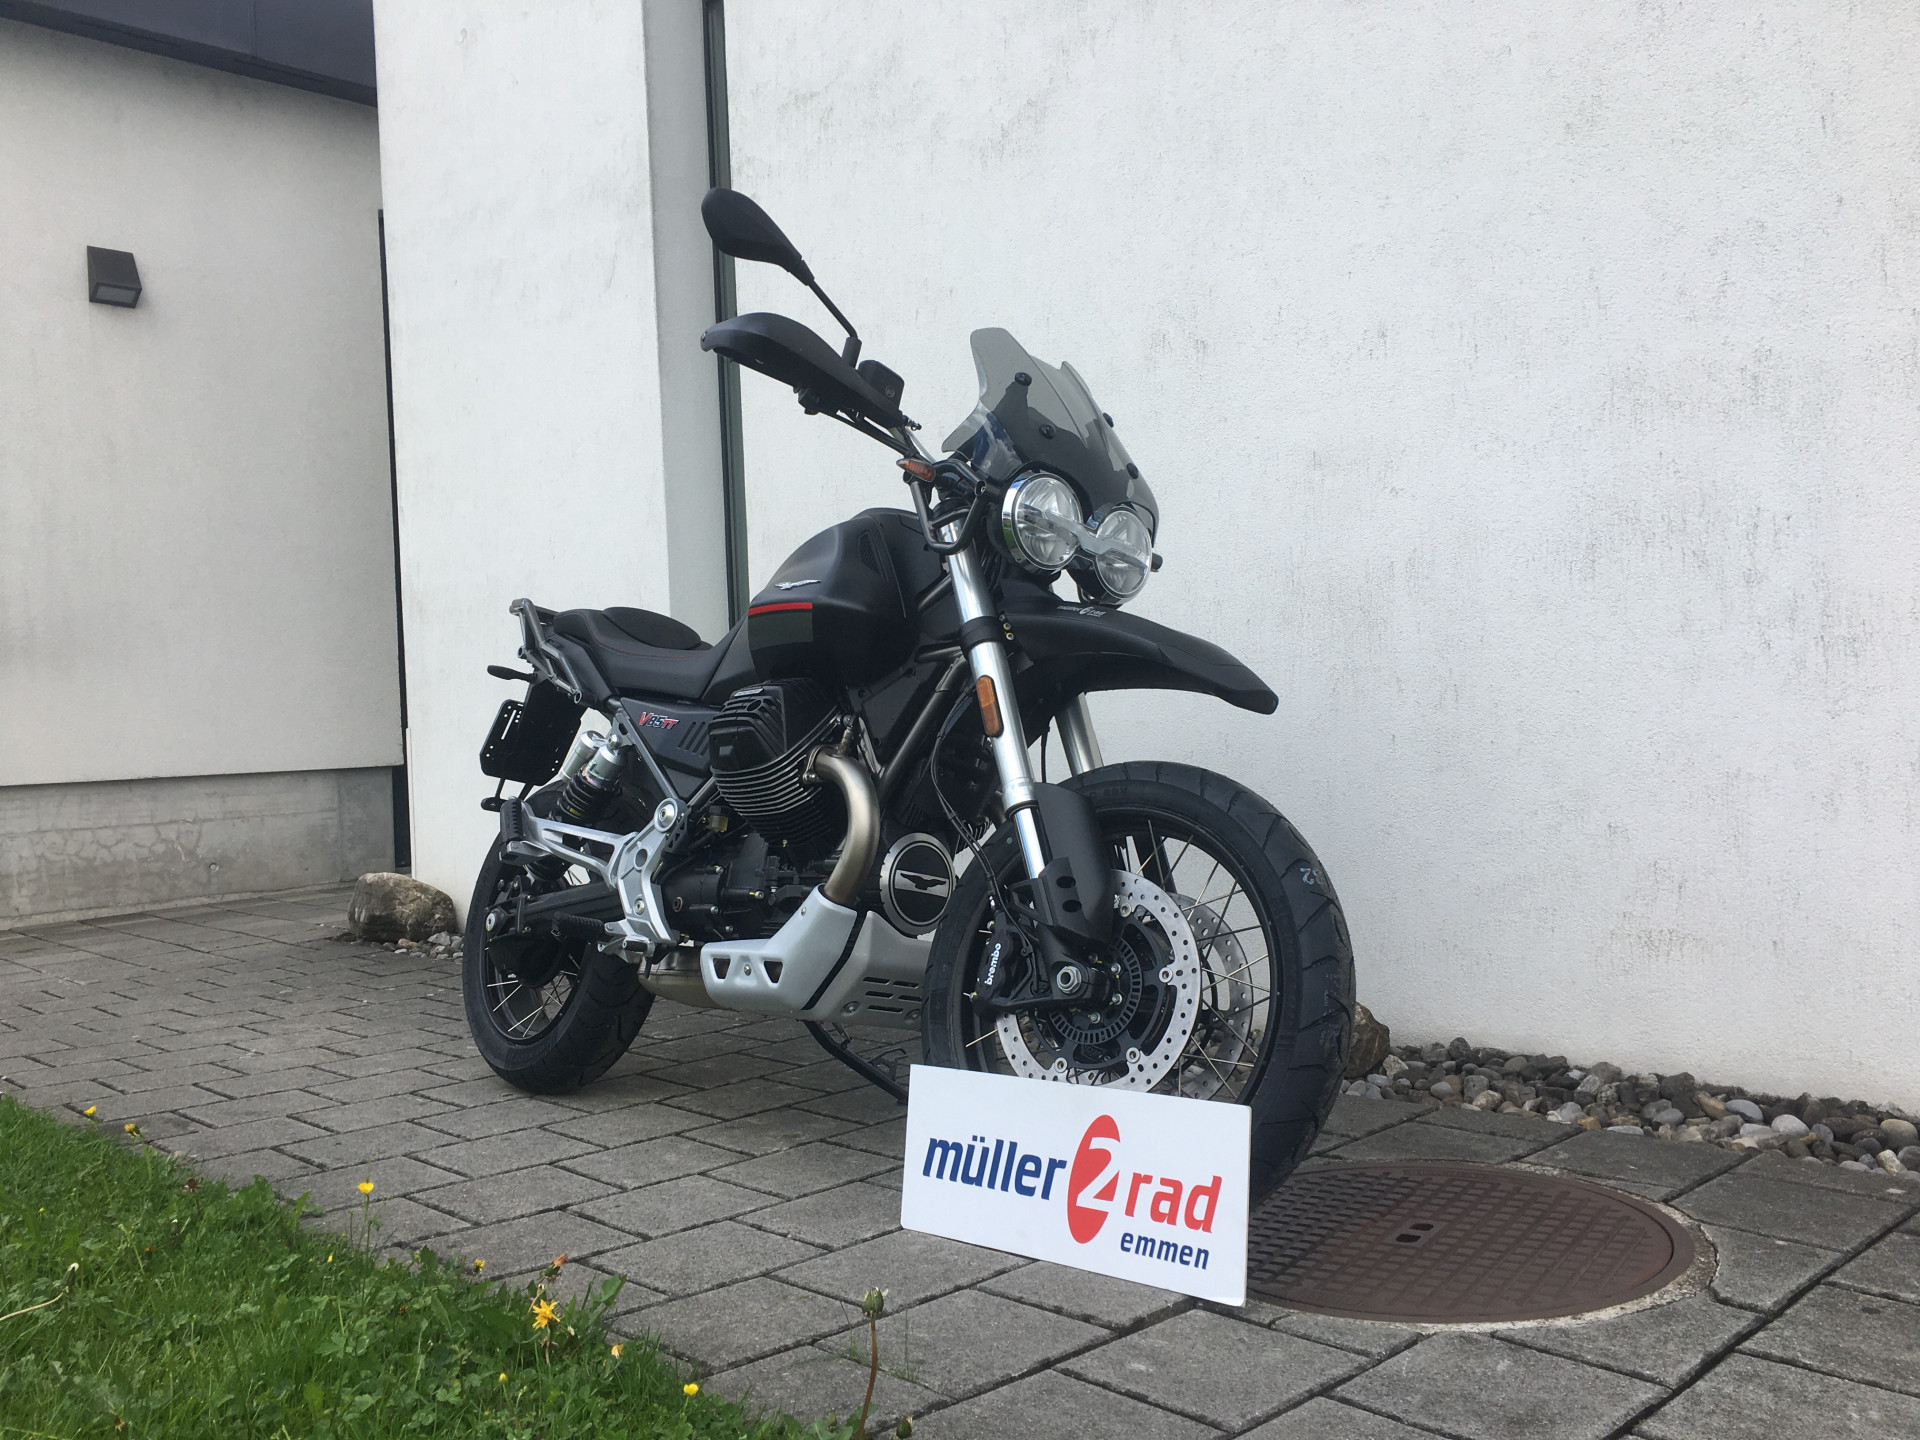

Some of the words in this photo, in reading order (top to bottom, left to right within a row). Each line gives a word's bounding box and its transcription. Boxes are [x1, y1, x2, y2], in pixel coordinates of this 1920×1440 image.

[639, 711, 680, 730] V85TT
[984, 942, 1002, 985] brembo
[922, 1134, 1067, 1201] müller
[1120, 1232, 1209, 1270] emmen
